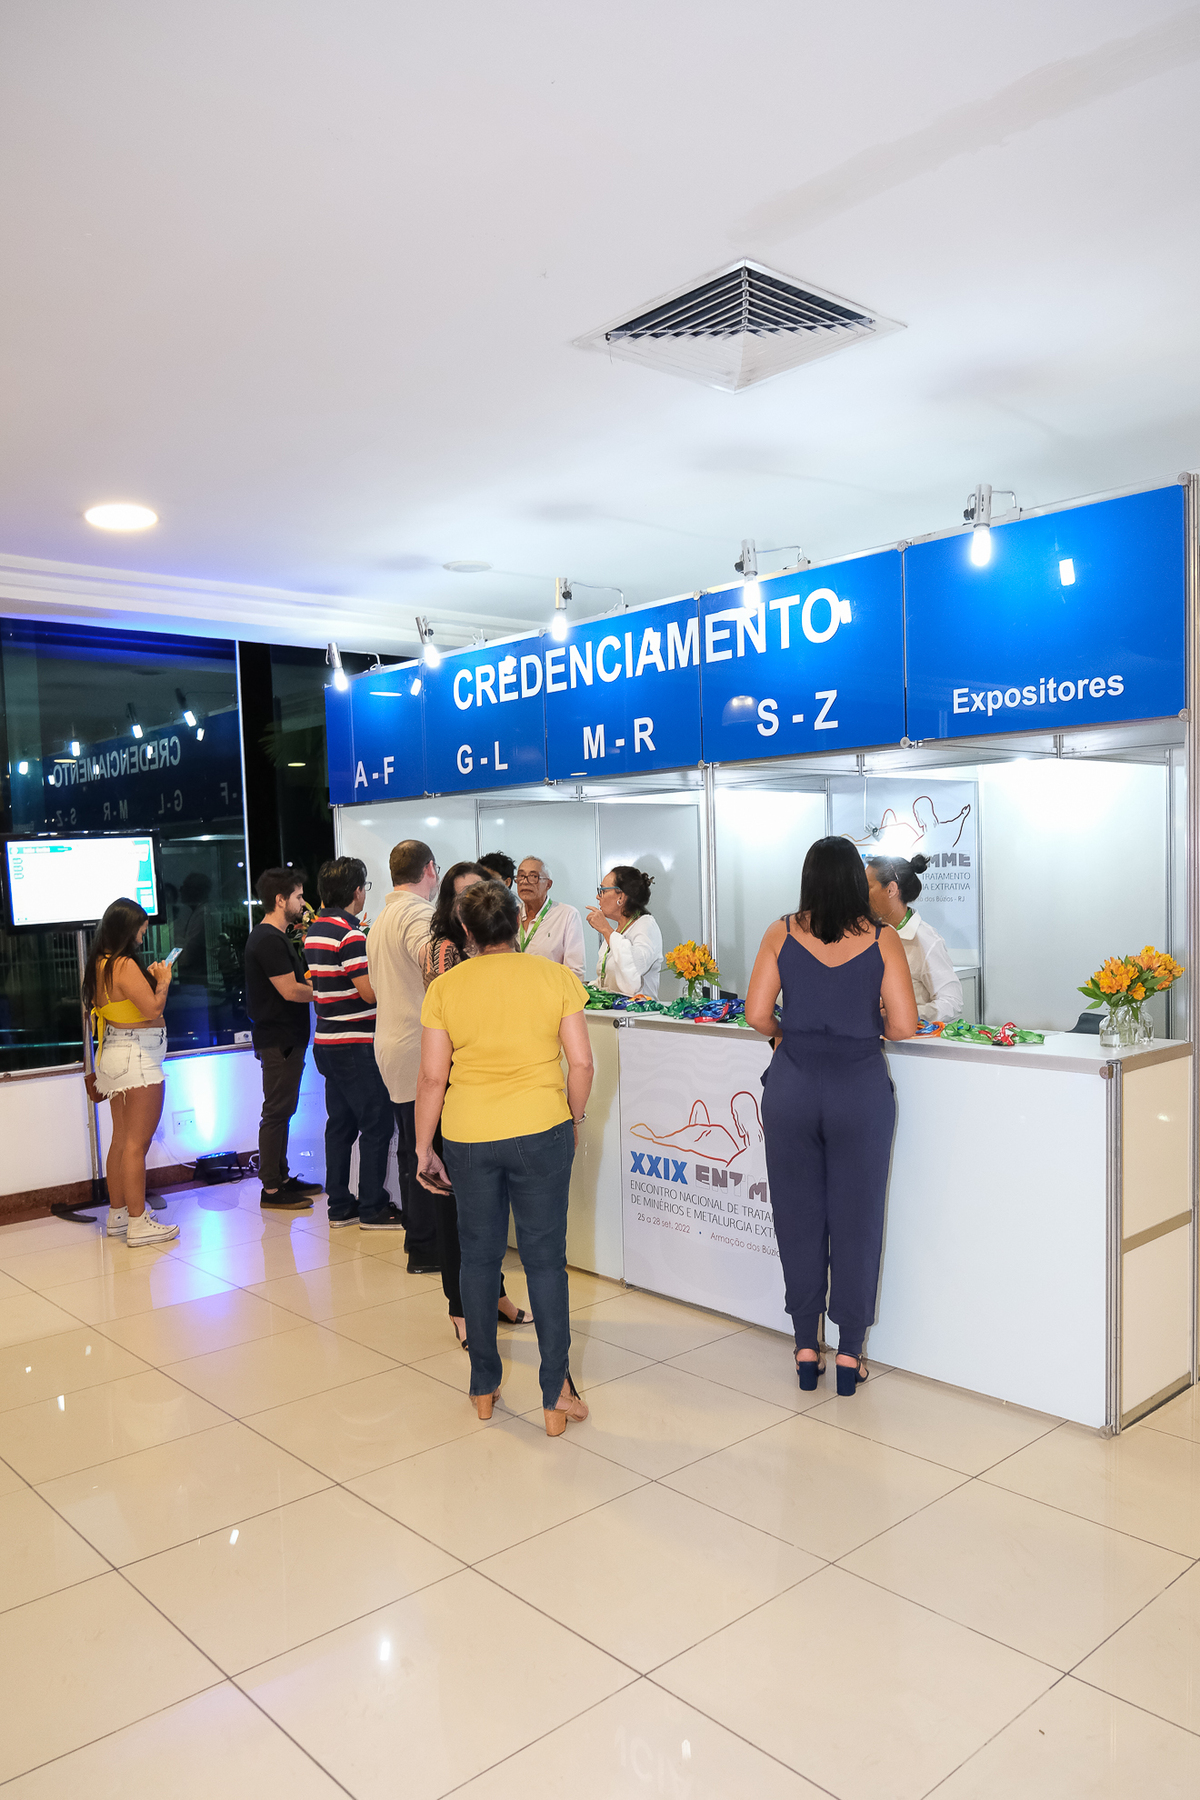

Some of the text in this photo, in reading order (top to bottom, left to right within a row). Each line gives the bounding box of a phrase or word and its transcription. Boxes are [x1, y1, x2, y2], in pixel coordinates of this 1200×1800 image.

[453, 587, 841, 711] CREDENCIAMENTO
[757, 698, 779, 737] S
[814, 689, 840, 731] Z
[952, 674, 1125, 717] Expositores
[583, 723, 606, 760] M
[634, 716, 656, 754] R
[354, 760, 369, 789] A
[383, 755, 395, 785] F
[456, 744, 474, 775] G
[494, 740, 509, 771] L
[927, 852, 971, 868] MME
[930, 883, 971, 891] EXTRATIVA
[630, 1151, 770, 1204] XXIX ENTM
[630, 1179, 678, 1201] ENCONTRO
[679, 1191, 725, 1213] NACIONAL
[727, 1203, 739, 1216] DE
[631, 1193, 643, 1207] DE
[643, 1196, 686, 1217] MINÉRIOS
[687, 1207, 692, 1219] E
[694, 1210, 753, 1233] METALURGIA
[637, 1212, 646, 1223] 25
[652, 1215, 661, 1227] 28
[674, 1221, 692, 1235] 2022
[710, 1232, 781, 1257] Armação dos Búzio
